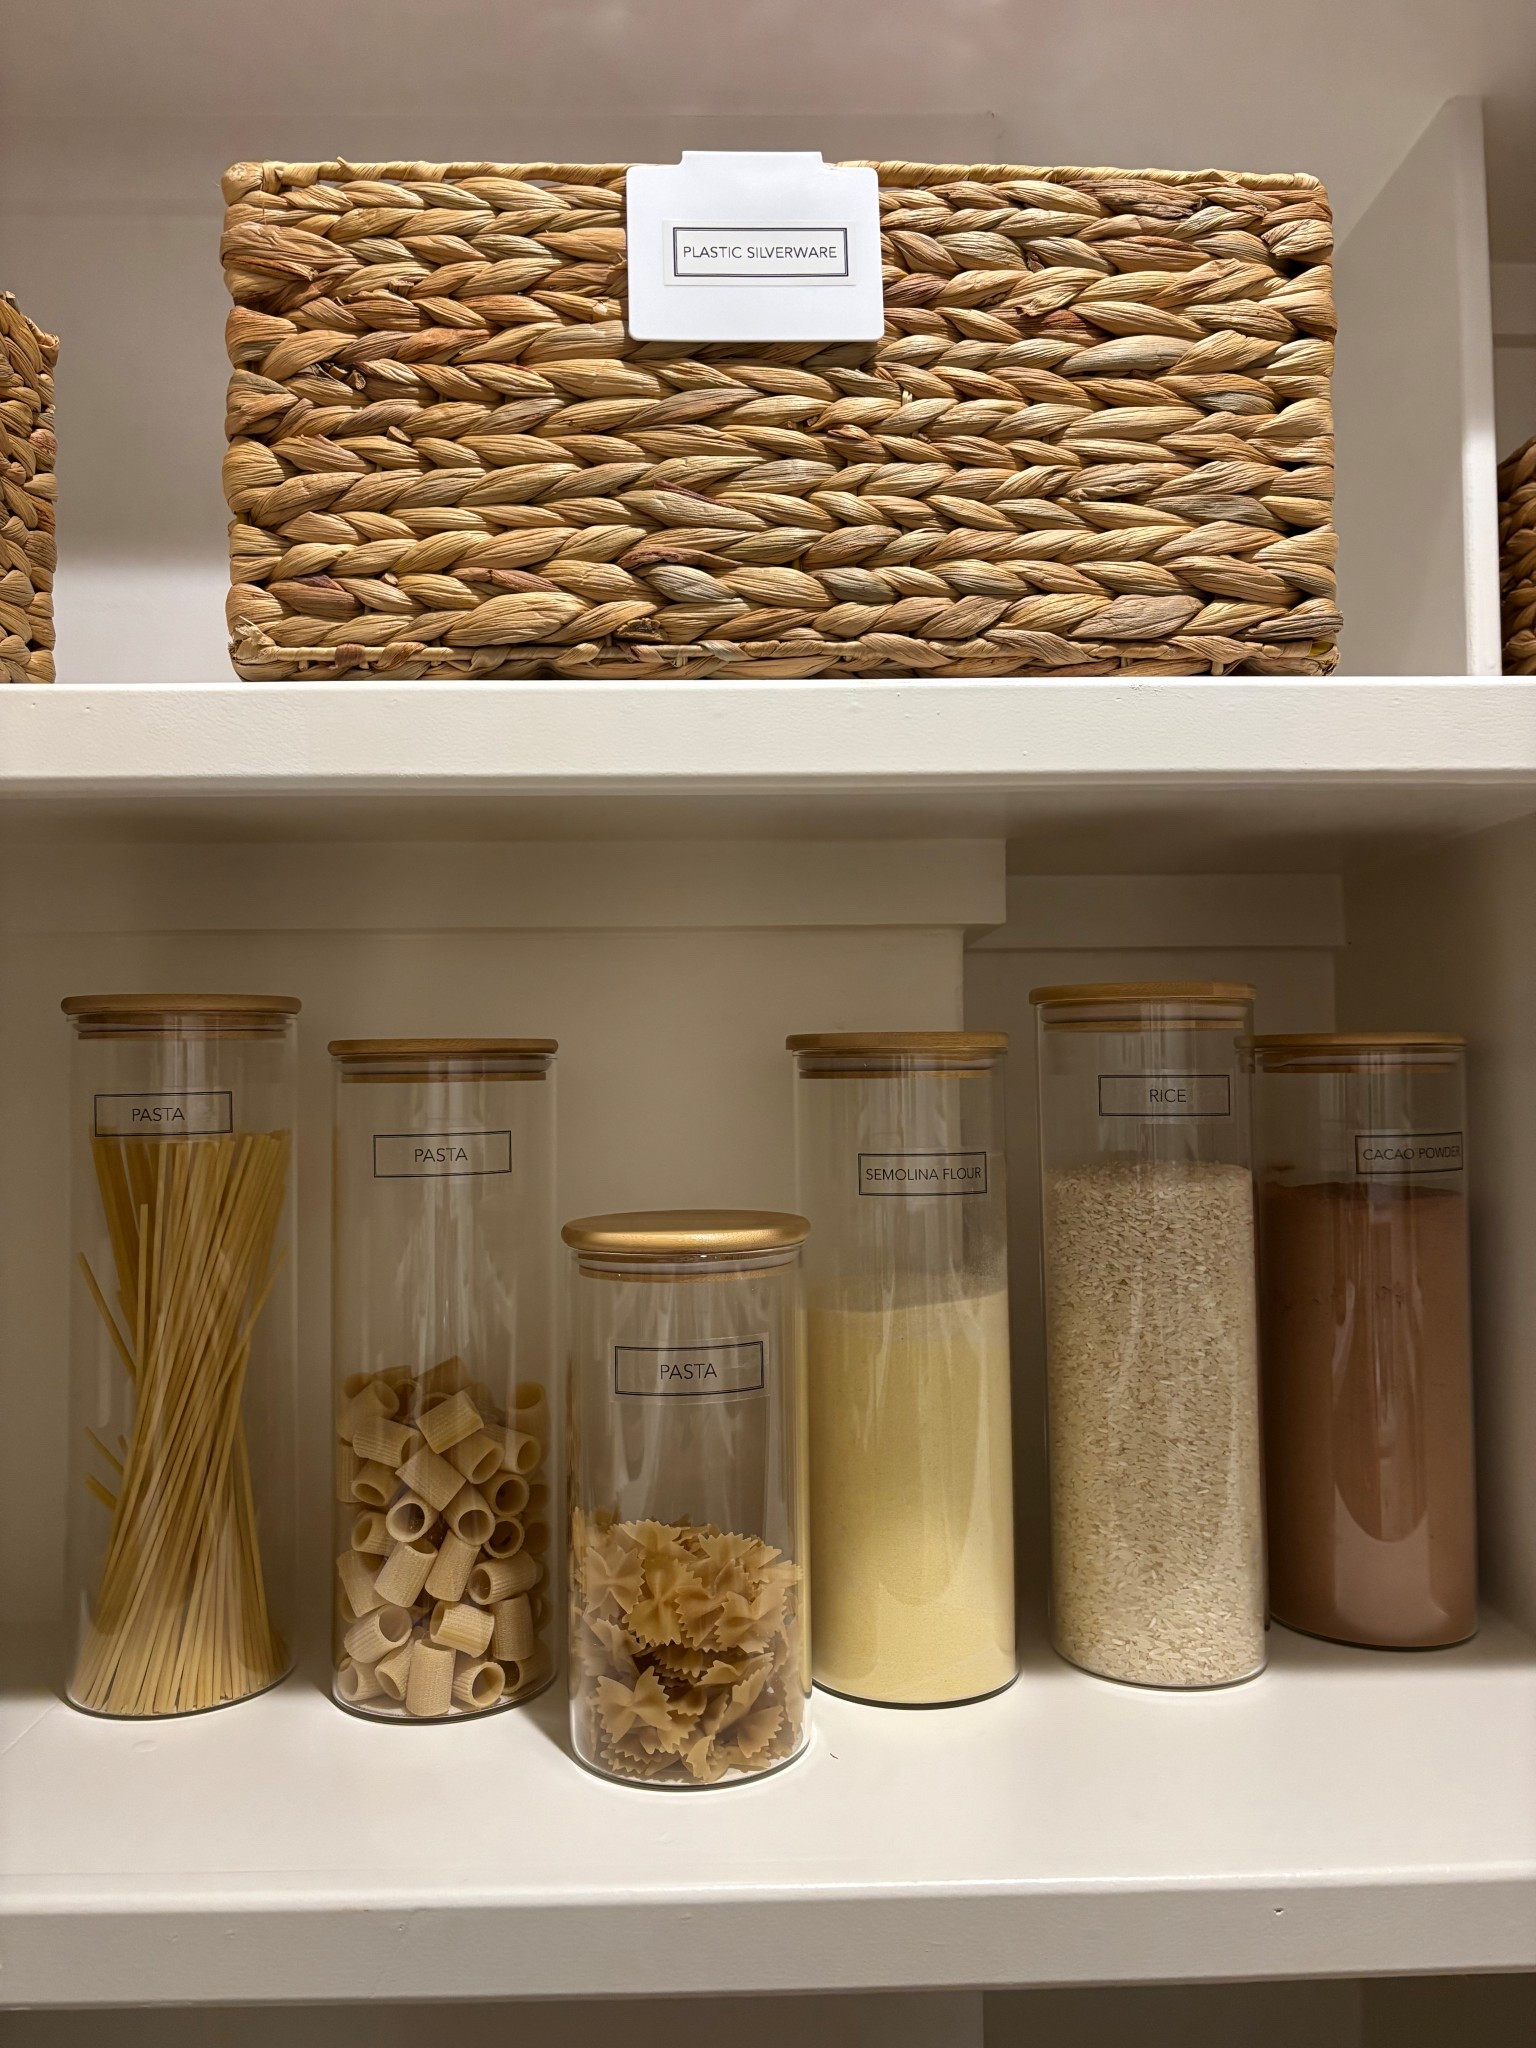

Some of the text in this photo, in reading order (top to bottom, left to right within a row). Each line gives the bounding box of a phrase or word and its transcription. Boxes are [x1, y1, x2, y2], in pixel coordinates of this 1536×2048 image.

[683, 246, 837, 259] PLASTIC SILVERWARE
[1149, 1089, 1187, 1103] RICE
[132, 1107, 186, 1122] PASTA
[414, 1147, 468, 1163] PASTA
[1362, 1145, 1460, 1160] CACAO POWDER
[865, 1167, 981, 1181] SEMOLINA FLOUR
[660, 1363, 718, 1380] PASTA
